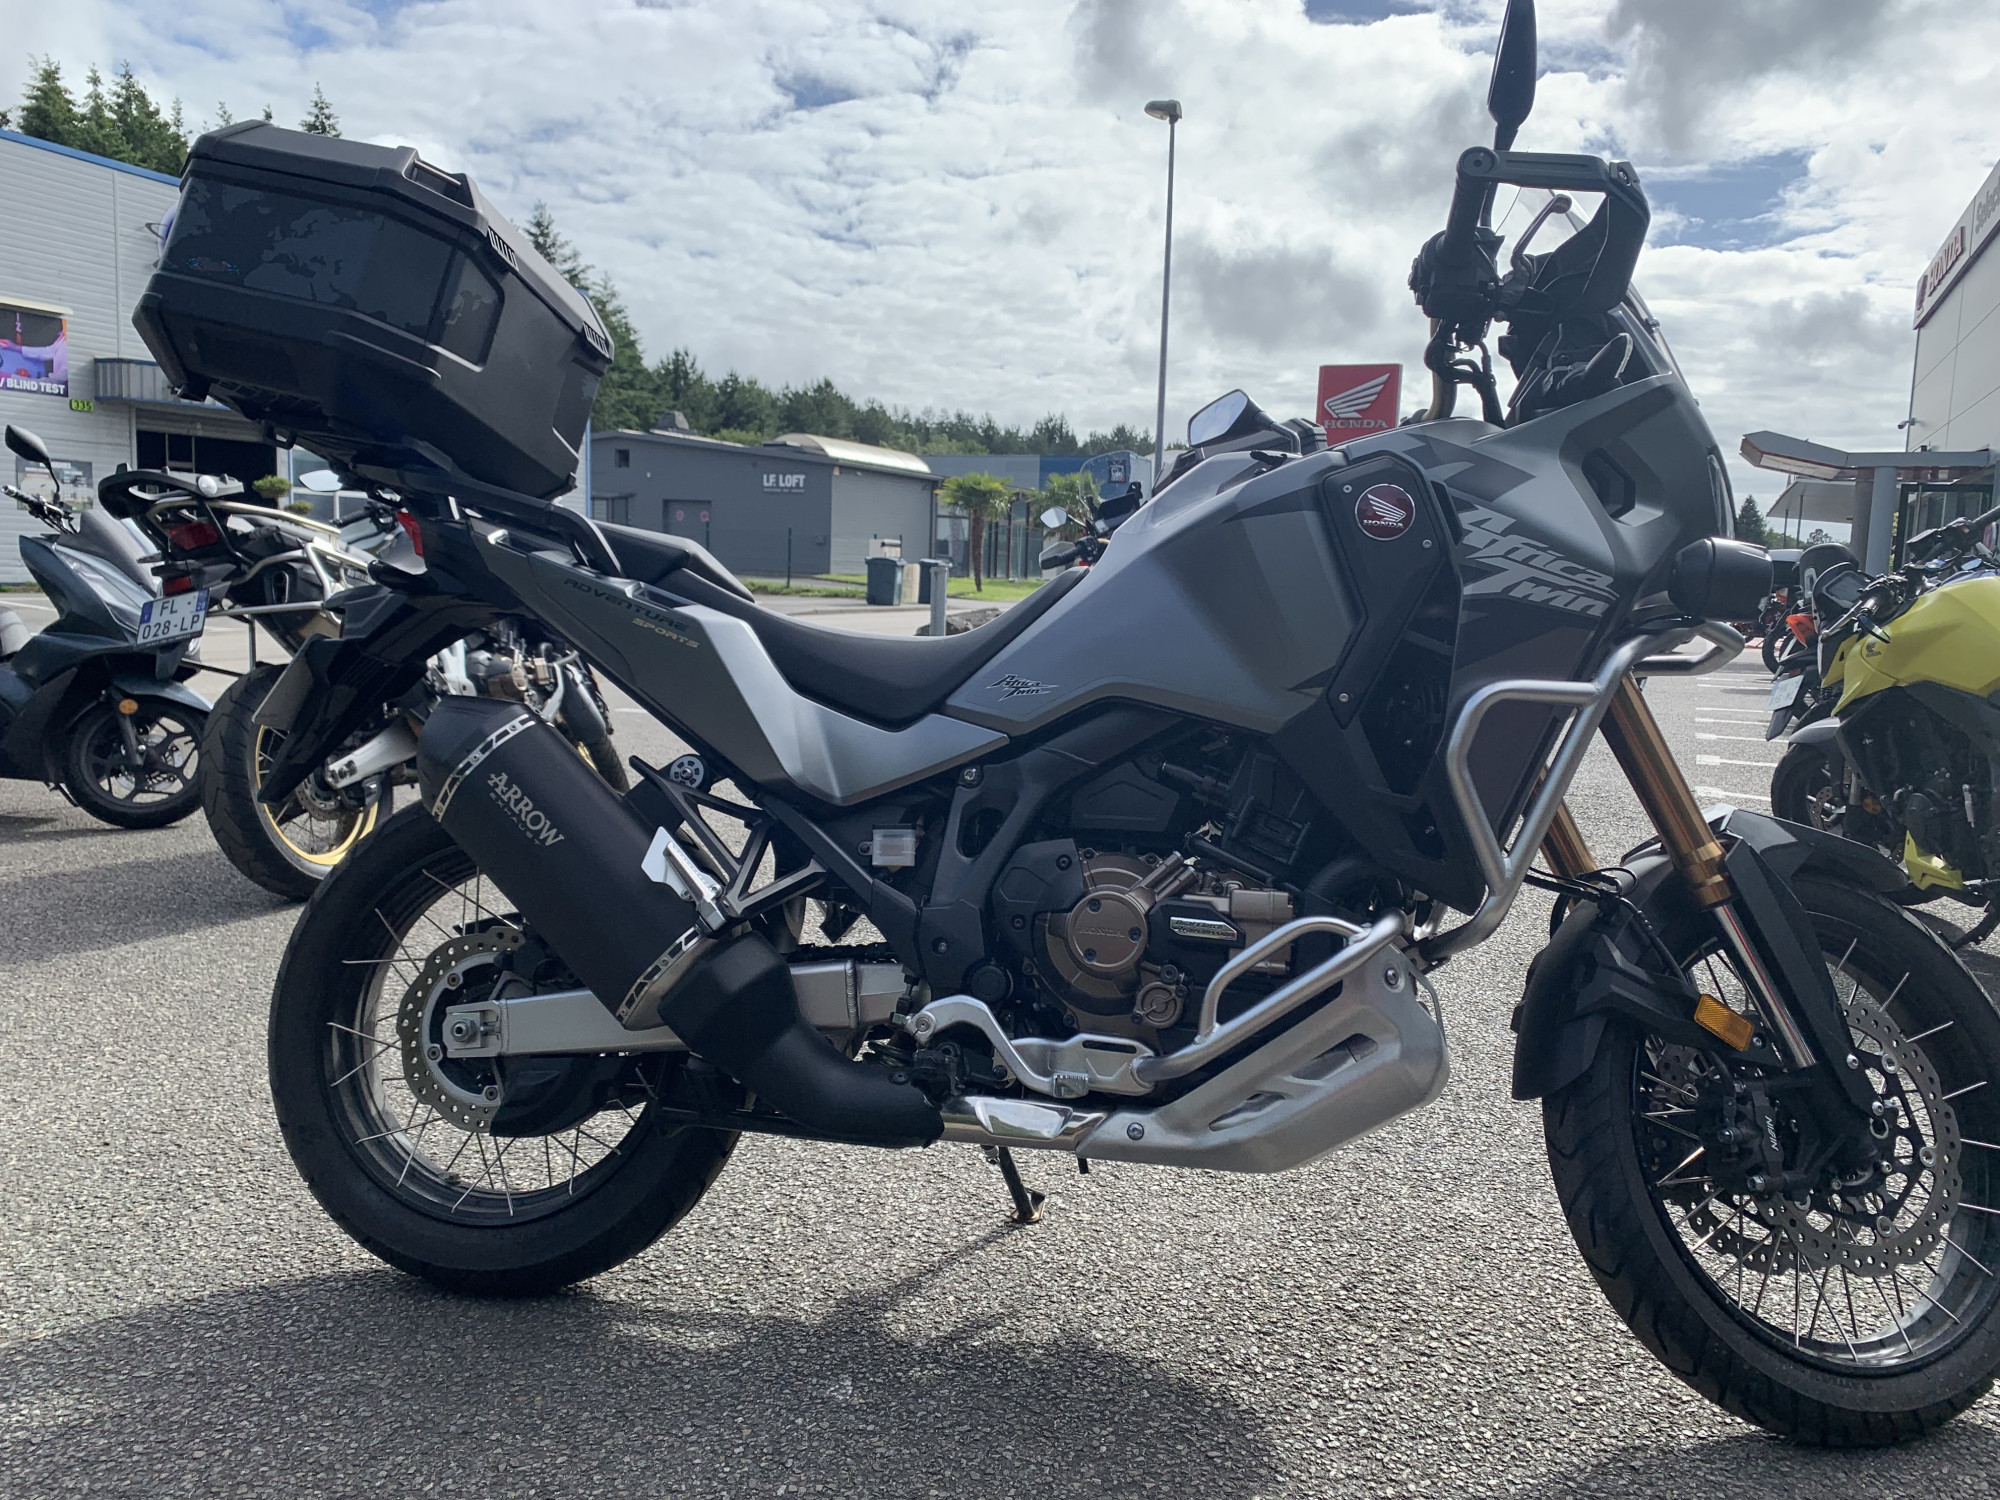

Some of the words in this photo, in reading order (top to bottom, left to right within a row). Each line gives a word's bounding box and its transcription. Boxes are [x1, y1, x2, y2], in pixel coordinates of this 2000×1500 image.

[6, 378, 38, 392] BLIND
[39, 382, 66, 395] TEST
[1323, 419, 1389, 430] HONDA
[778, 473, 806, 488] LOFT
[1362, 519, 1405, 529] HONDA
[1457, 503, 1620, 598] Africa
[1463, 556, 1617, 617] Twin
[160, 599, 178, 617] FL
[563, 577, 690, 633] ADVENTURE
[142, 614, 200, 640] 028-LP
[632, 617, 700, 649] SPORTS
[487, 772, 565, 847] ARROW
